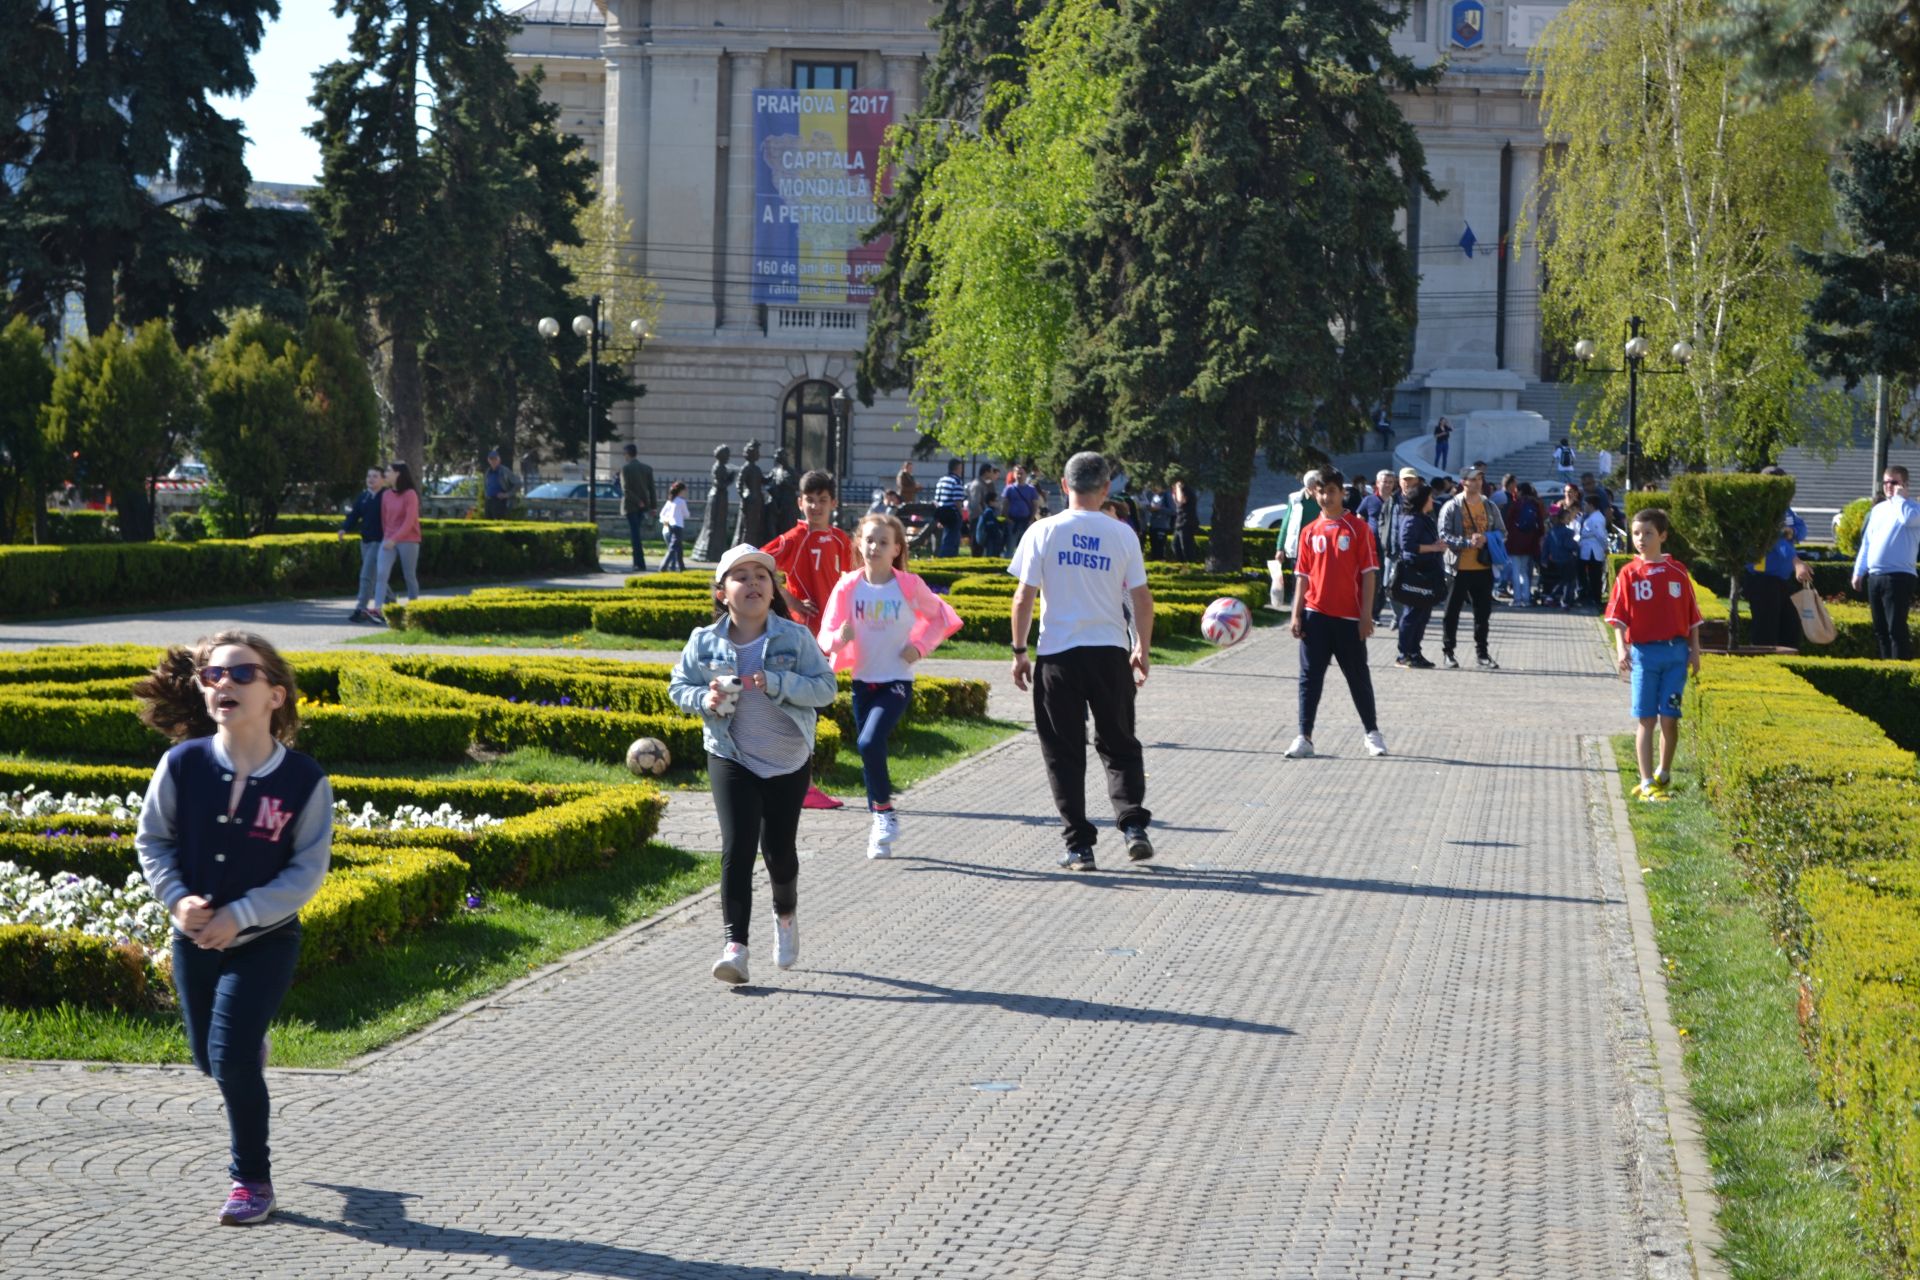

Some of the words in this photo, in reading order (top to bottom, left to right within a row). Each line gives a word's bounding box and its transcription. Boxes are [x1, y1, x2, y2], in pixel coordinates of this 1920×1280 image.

[757, 95, 835, 114] PRAHOVA
[849, 96, 889, 114] 2017
[782, 151, 865, 169] CAPITALA
[762, 204, 774, 223] A
[779, 204, 878, 224] PETROLULU
[757, 260, 778, 275] 160
[781, 261, 796, 275] de
[822, 261, 836, 275] de
[841, 261, 852, 275] la
[855, 260, 881, 278] prim
[1072, 533, 1100, 551] CSM
[1311, 534, 1327, 553] 10
[811, 548, 822, 571] 7
[1632, 580, 1653, 601] 18
[855, 600, 901, 621] HAPPY
[254, 796, 293, 841] NY
